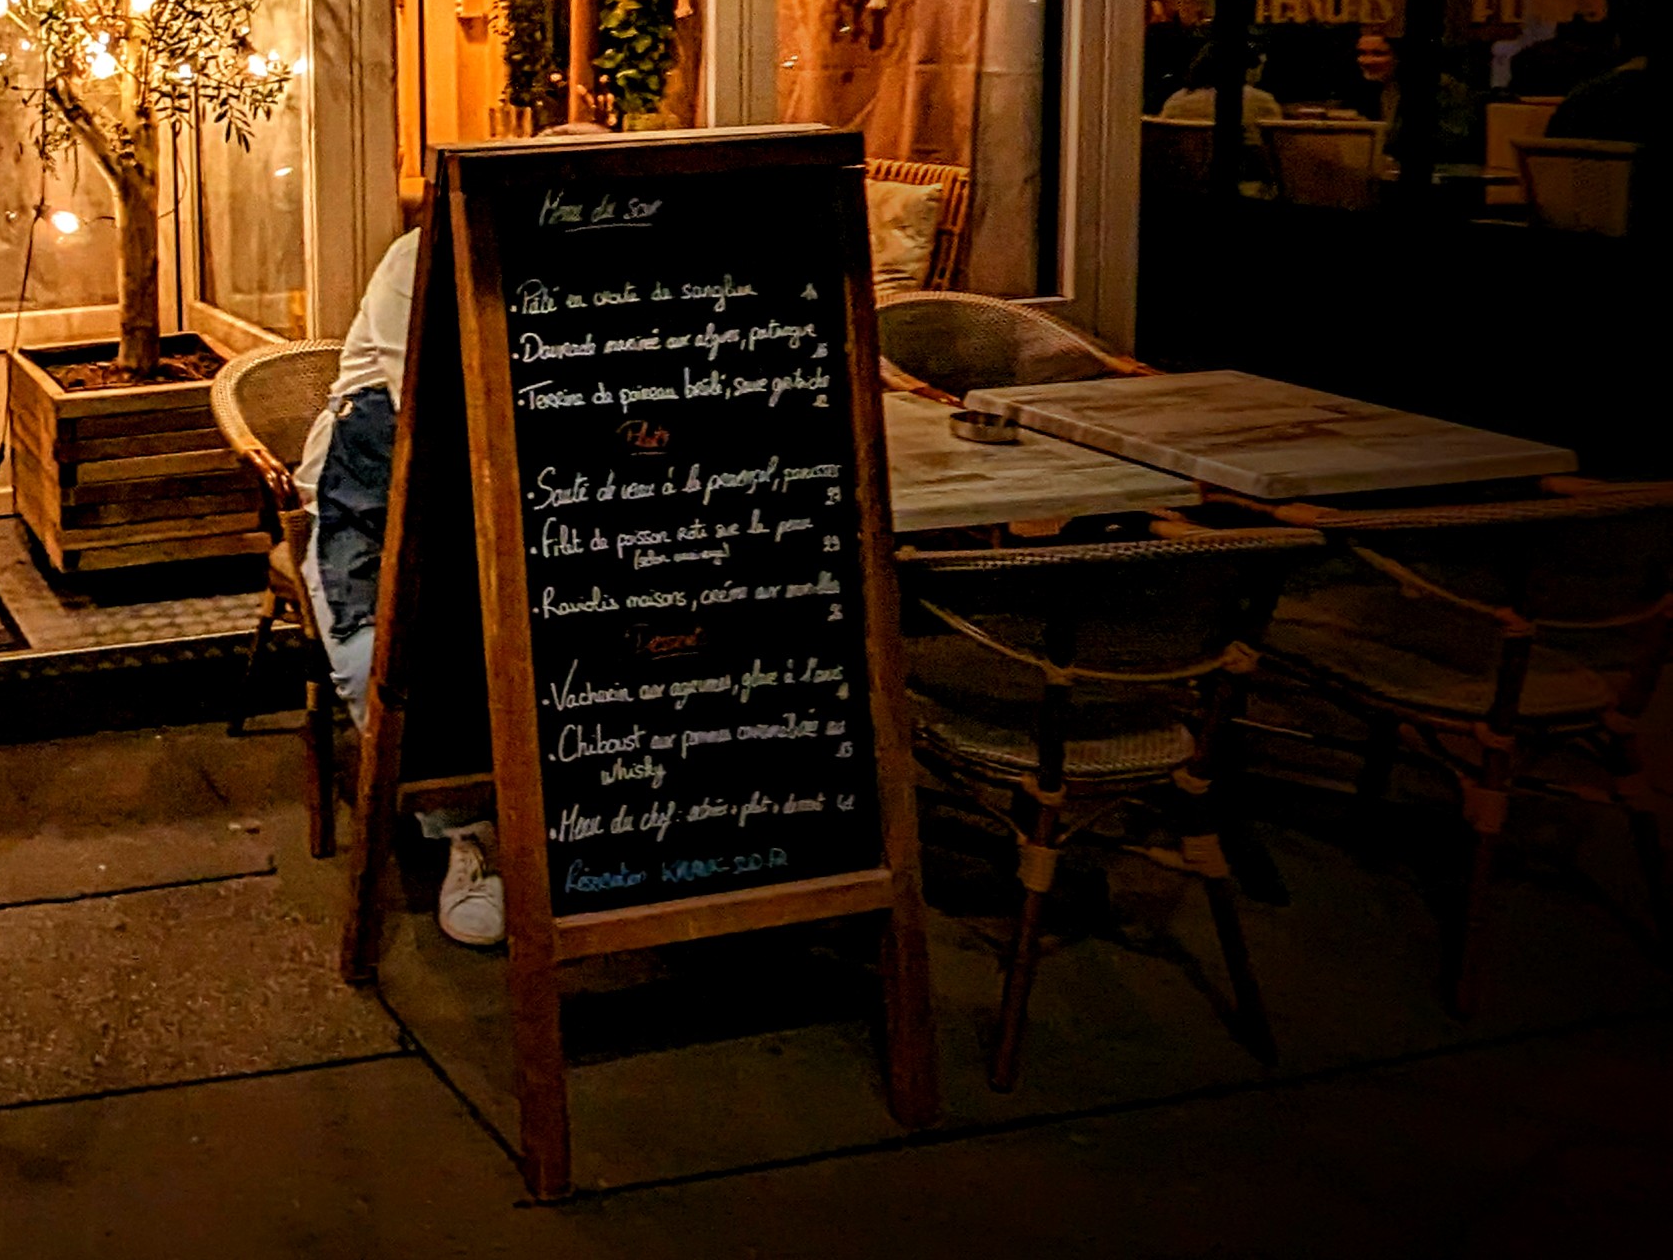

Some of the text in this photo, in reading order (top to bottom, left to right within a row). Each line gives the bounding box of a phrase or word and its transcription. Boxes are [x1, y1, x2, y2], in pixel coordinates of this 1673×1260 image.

[591, 382, 615, 405] de
[533, 466, 590, 511] Sauté
[590, 527, 611, 552] de
[541, 586, 621, 619] Raviolis
[549, 659, 635, 712] Vacherin
[558, 723, 647, 763] Chiboust
[600, 755, 667, 789] whisky
